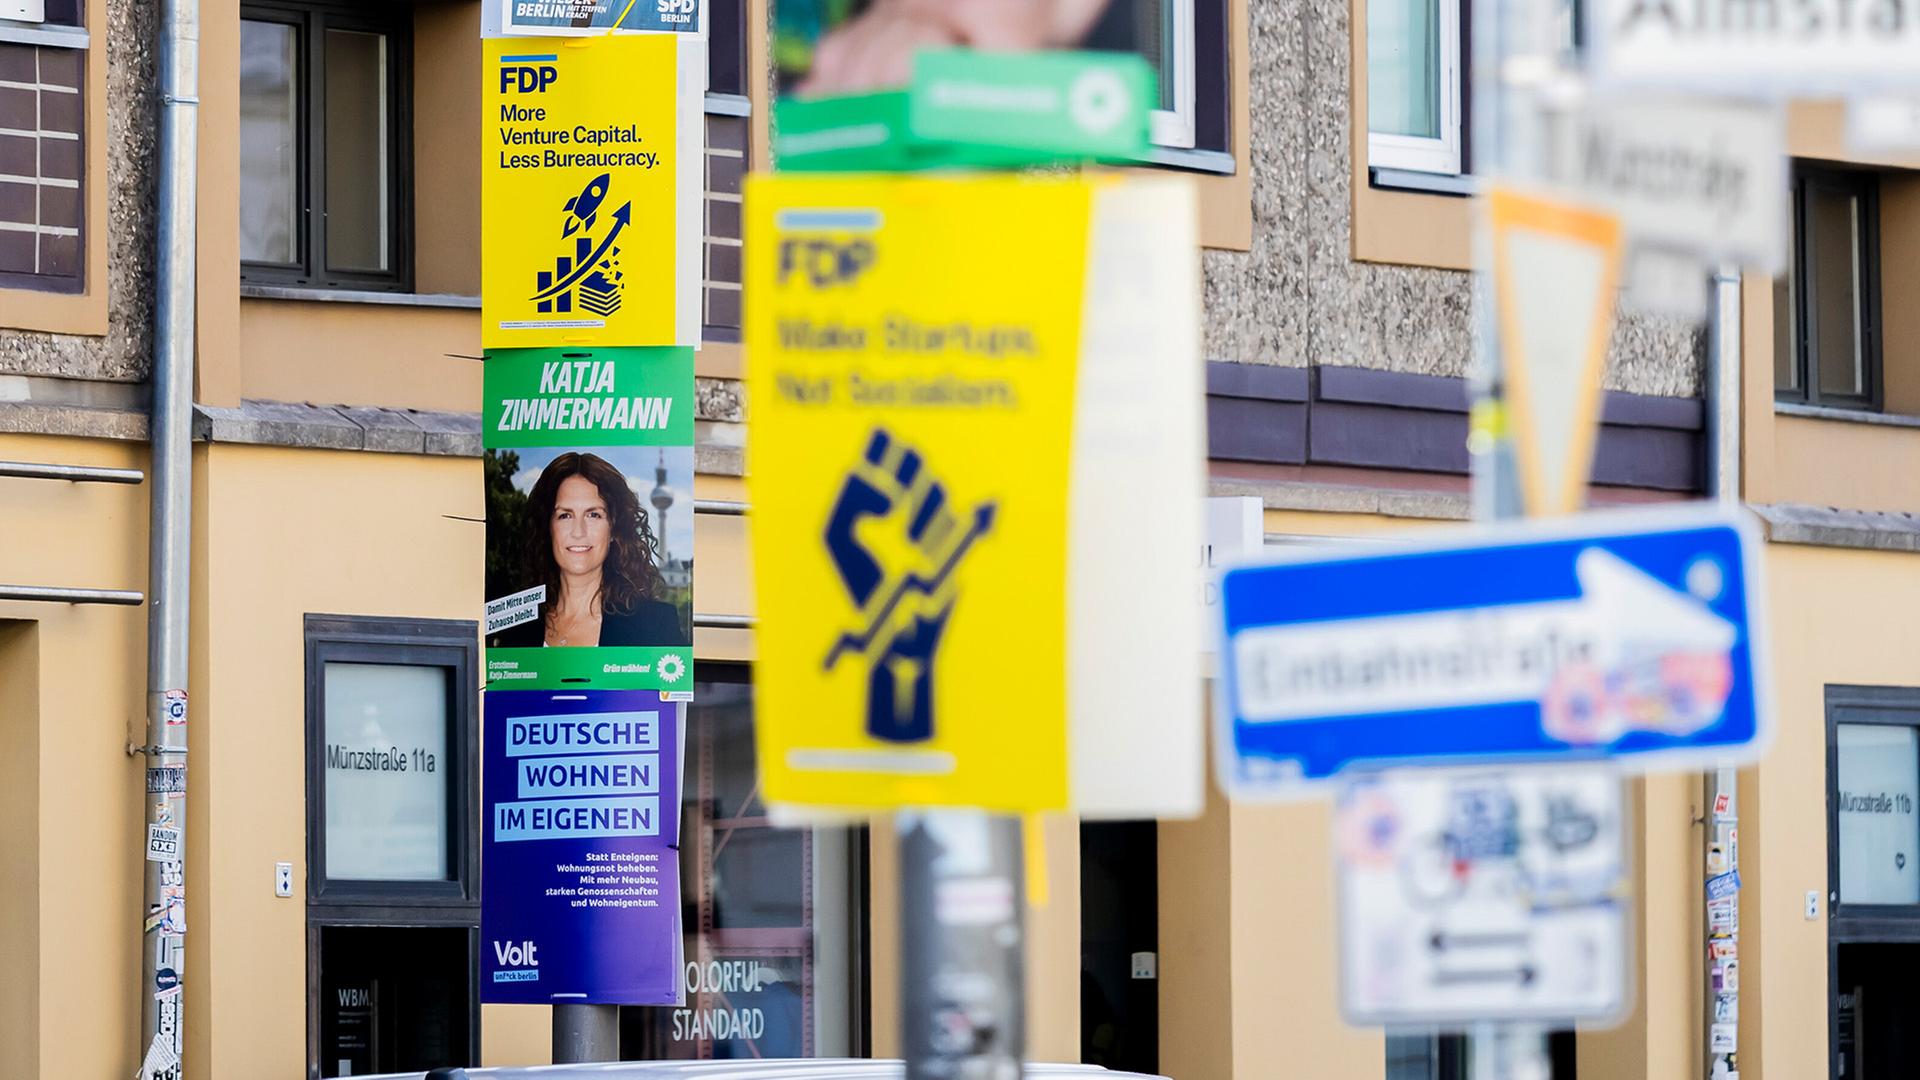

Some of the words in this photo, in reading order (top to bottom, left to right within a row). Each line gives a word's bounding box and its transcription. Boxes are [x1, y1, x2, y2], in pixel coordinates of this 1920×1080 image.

[516, 3, 566, 18] BERLIN
[657, 0, 694, 13] SPD
[1611, 0, 1920, 36] Almsta
[660, 14, 690, 23] BERLIN
[500, 66, 558, 94] FDP
[500, 104, 546, 122] More
[500, 128, 569, 145] Venture
[573, 125, 642, 146] Capital.
[500, 151, 540, 169] Less
[543, 149, 660, 169] Bureaucracy.
[776, 238, 879, 291] FDP
[776, 315, 866, 353] Make
[539, 360, 615, 393] KATJA
[776, 373, 832, 408] Not
[497, 397, 672, 431] ZIMMERMANN
[488, 602, 505, 615] Damit
[506, 597, 522, 609] Mitte
[523, 591, 542, 604] unser
[488, 616, 514, 631] Zuhause
[514, 608, 535, 622] bleibt.
[603, 664, 621, 673] Grün
[512, 722, 650, 746] DEUTSCHE
[328, 744, 407, 771] Münzstraße
[412, 748, 436, 772] 11a
[525, 764, 650, 787] WOHNEN
[1896, 793, 1911, 814] 11b
[500, 808, 526, 830] IM
[532, 807, 651, 830] EIGENEN
[557, 864, 615, 874] Wohnungsnot
[617, 864, 659, 873] beheben.
[586, 853, 609, 861] Statt
[611, 853, 659, 863] Enteignen:
[545, 887, 576, 896] starken
[577, 887, 659, 896] Genossenschaften
[580, 876, 595, 884] Mit
[597, 876, 620, 884] mehr
[622, 876, 659, 885] Neubau,
[571, 899, 587, 908] und
[589, 899, 659, 909] Wohneigentum.
[494, 941, 538, 966] Volt
[517, 971, 537, 980] berlin
[686, 961, 763, 993] OLORFUL
[338, 989, 373, 1007] WBM.
[672, 1008, 764, 1041] STANDARD
